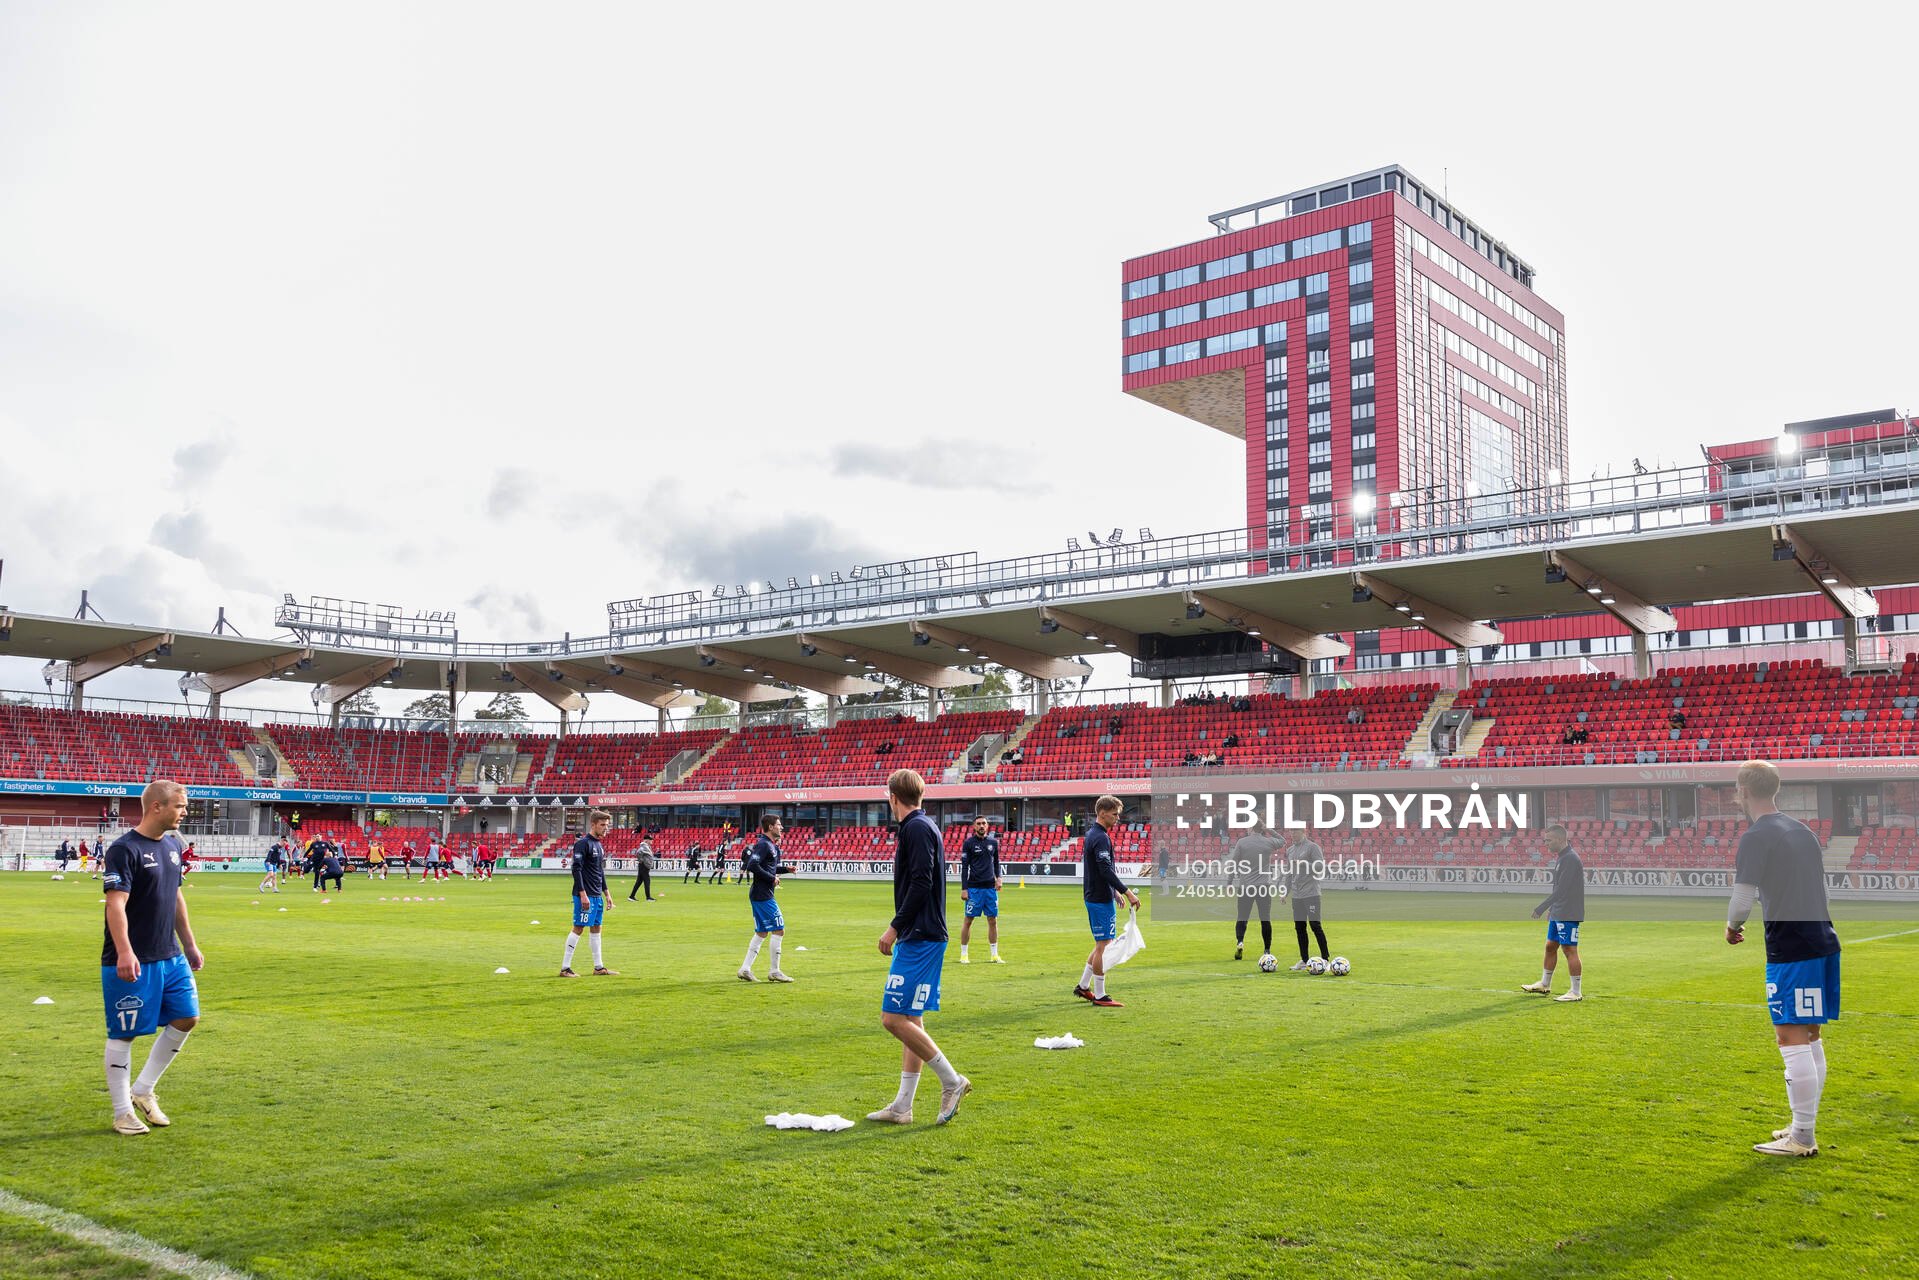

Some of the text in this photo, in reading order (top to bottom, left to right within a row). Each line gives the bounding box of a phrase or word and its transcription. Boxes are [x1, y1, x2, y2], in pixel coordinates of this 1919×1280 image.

[1465, 774, 1493, 784] VISMA
[1653, 769, 1688, 779] VISMA
[1300, 778, 1325, 787] VISMA
[94, 785, 127, 794] bravida
[252, 791, 281, 799] bravida
[874, 862, 893, 873] OCH
[1444, 869, 1464, 883] DE
[1467, 867, 1554, 884] FÖRÄDLAD
[1584, 868, 1684, 886] RÄVARORNA
[1688, 872, 1728, 887] OCH
[117, 1010, 138, 1031] 17
